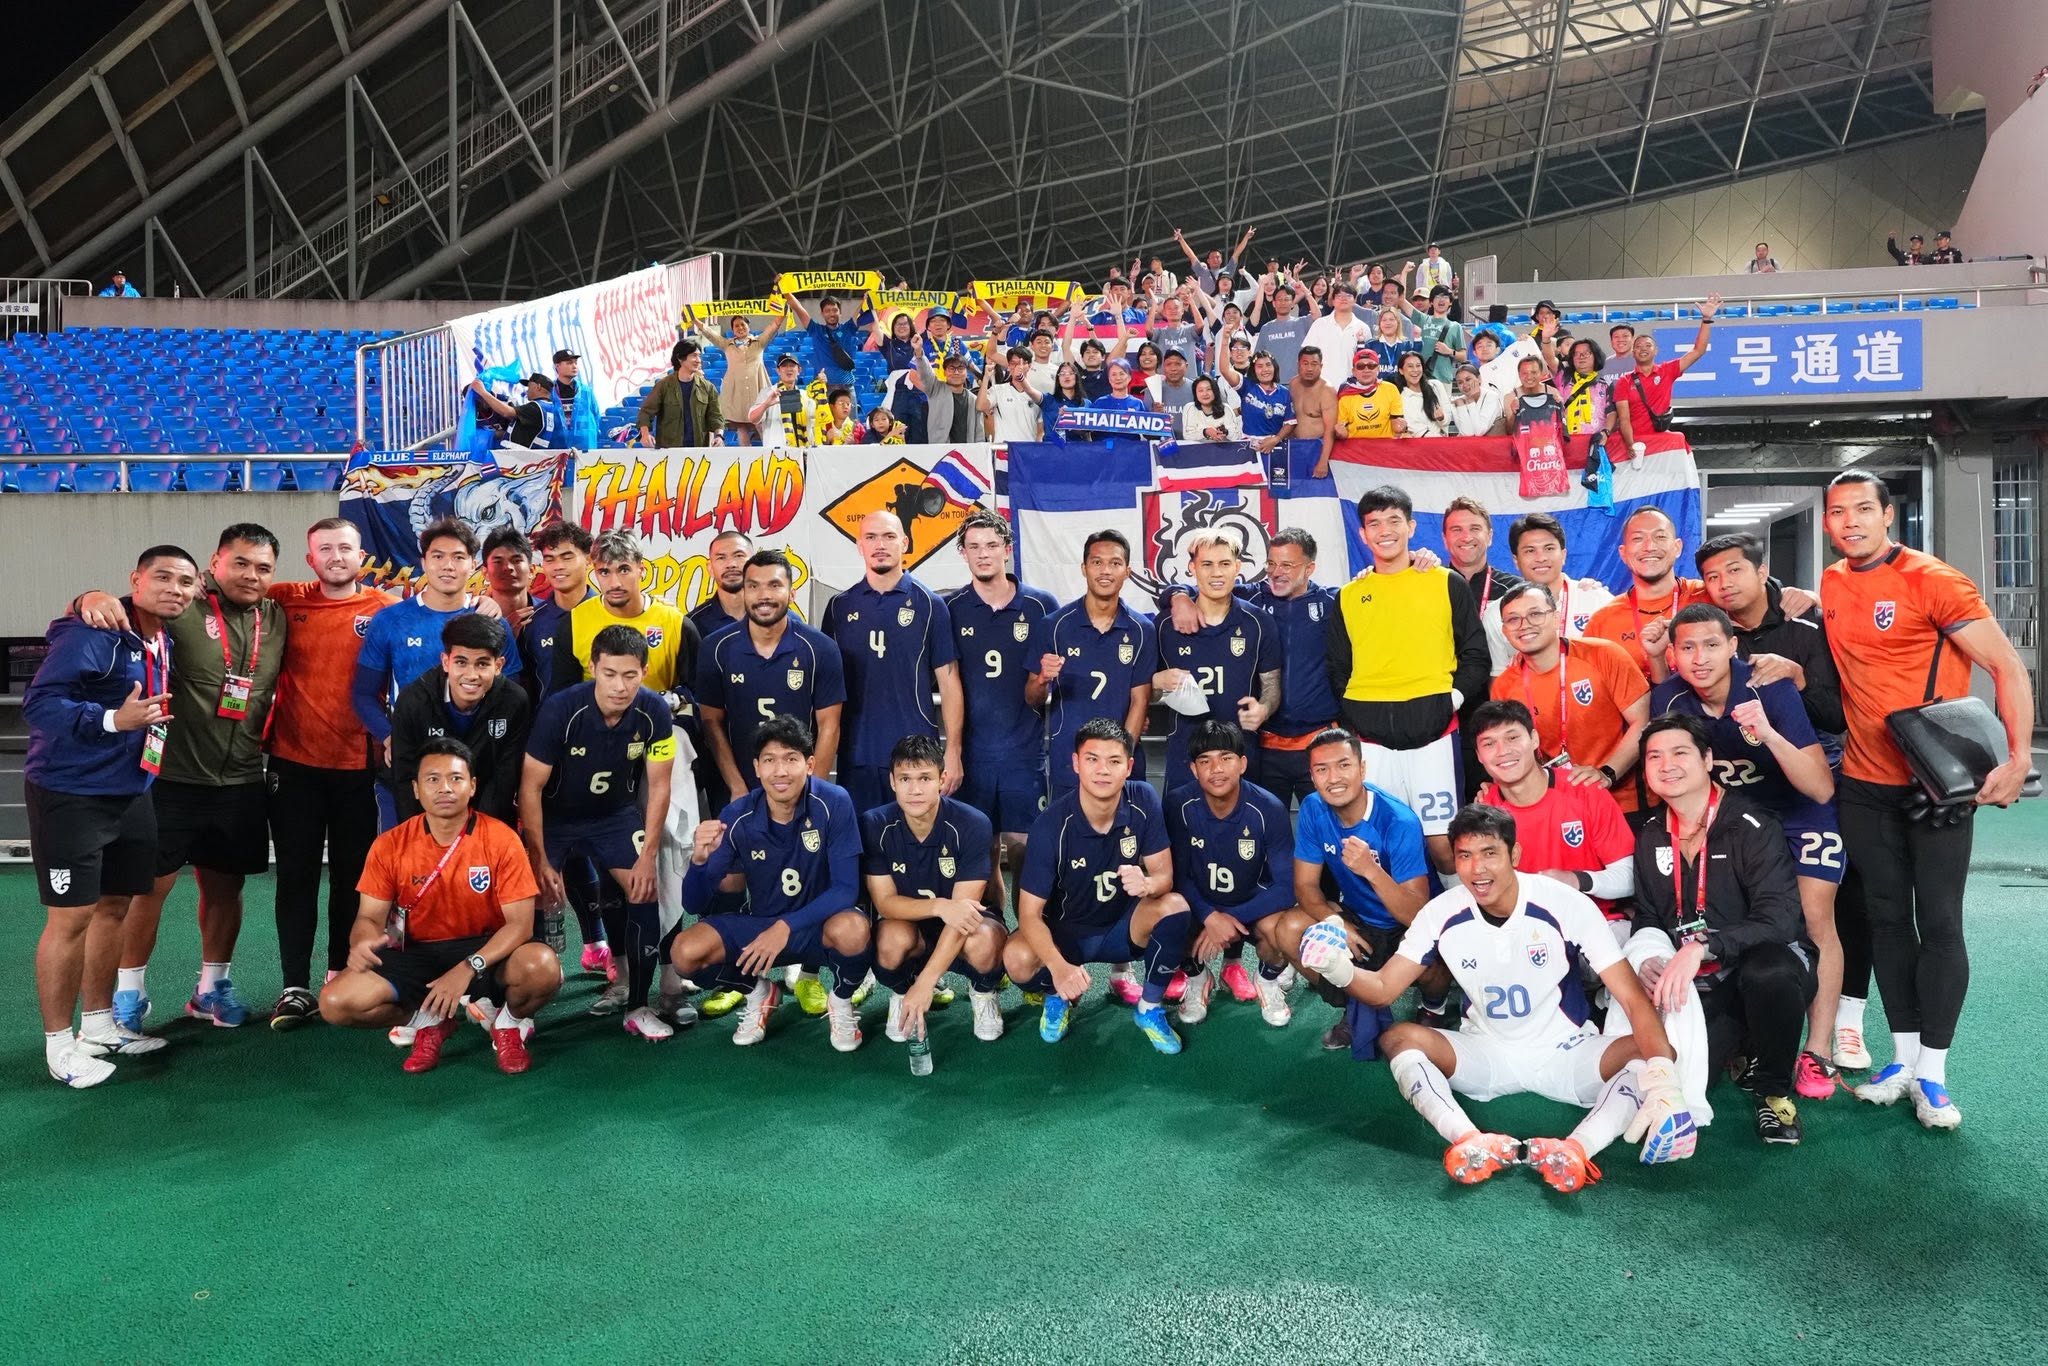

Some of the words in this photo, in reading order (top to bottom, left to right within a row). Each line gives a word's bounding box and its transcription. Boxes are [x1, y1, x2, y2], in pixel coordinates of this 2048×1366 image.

[793, 272, 865, 289] THAILAND
[986, 281, 1054, 296] THAILAND
[877, 291, 948, 306] THAILAND
[1268, 331, 1296, 341] THAILAND
[1674, 330, 1904, 386] 二号通道
[1073, 412, 1165, 431] THAILAND
[1163, 405, 1183, 414] HAILA
[373, 452, 410, 463] BLUE
[432, 451, 470, 461] ELEPHANT
[576, 451, 804, 544] THAILAND
[940, 511, 950, 520] ON
[869, 630, 886, 659] 4
[984, 649, 1002, 678] 9
[1090, 671, 1107, 700] 7
[1197, 665, 1224, 695] 21
[757, 698, 776, 726] 5
[589, 771, 613, 795] 6
[1712, 759, 1765, 787] 22
[1419, 791, 1455, 822] 23
[1800, 831, 1843, 869] 22
[781, 868, 801, 897] 8
[1093, 871, 1118, 902] 15
[1207, 862, 1235, 893] 19
[1484, 984, 1531, 1019] 20
